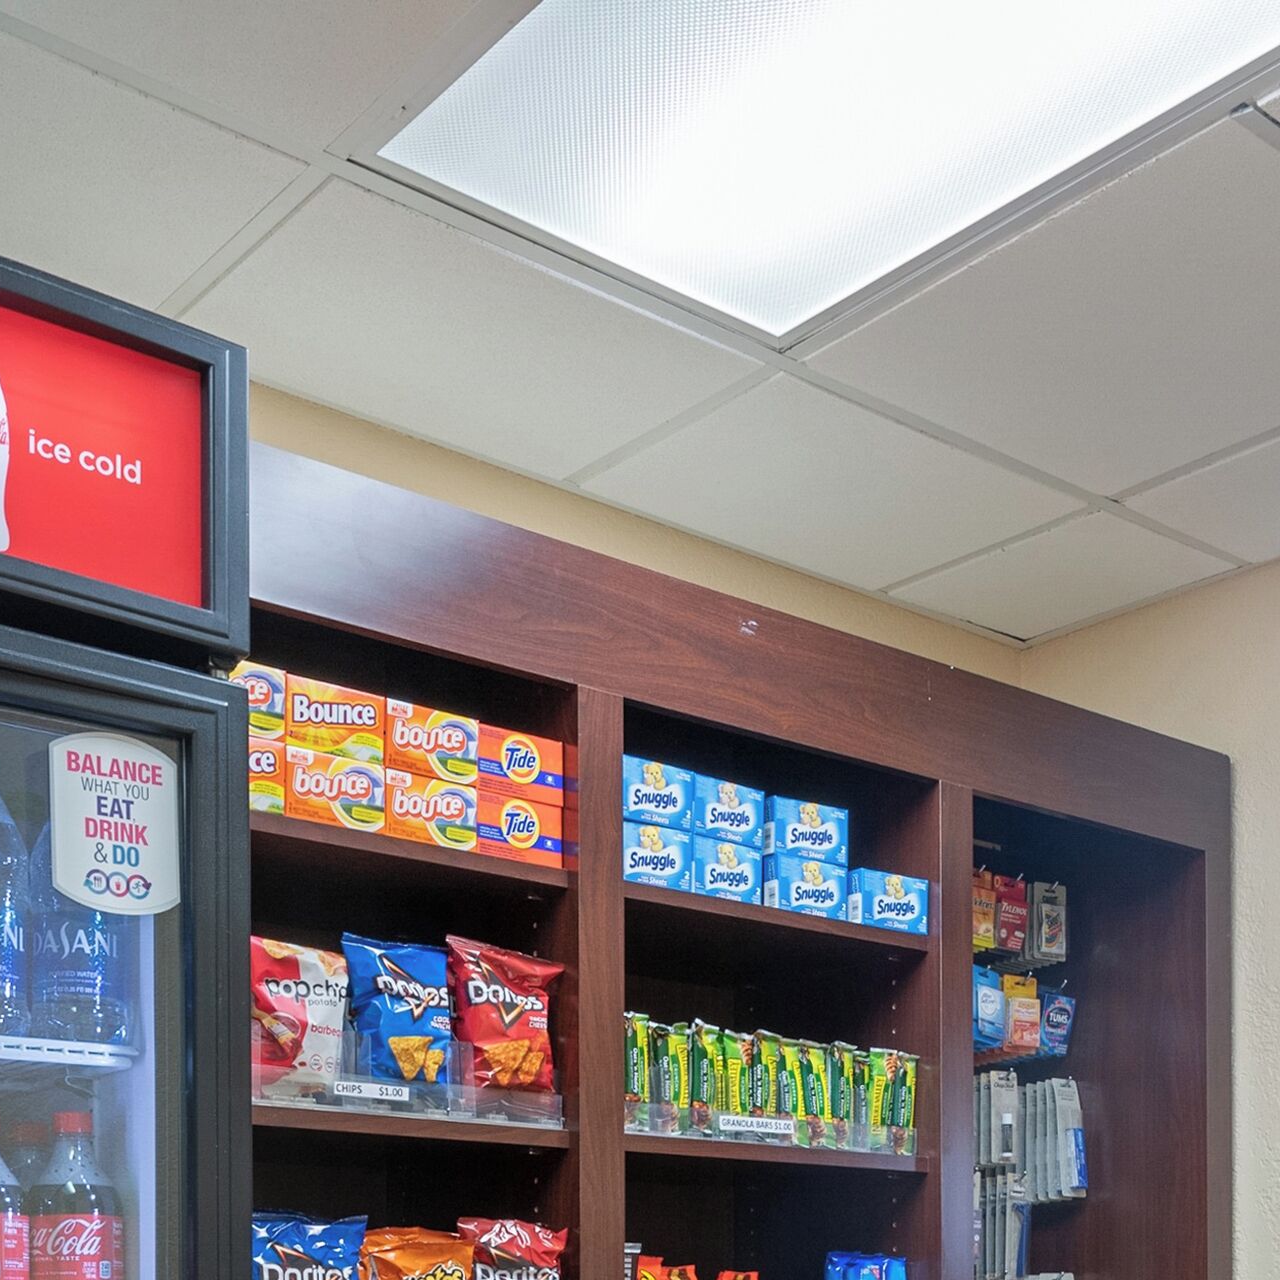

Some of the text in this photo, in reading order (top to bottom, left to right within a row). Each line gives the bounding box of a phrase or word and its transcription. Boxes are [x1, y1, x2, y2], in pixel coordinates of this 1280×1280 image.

[28, 429, 142, 485] ice cold
[292, 694, 376, 726] Bounce
[393, 719, 466, 754] bounce
[66, 750, 163, 786] BALANCE
[505, 748, 536, 771] Tide
[81, 776, 150, 801] WHAT YOU
[293, 766, 372, 803] bounce
[96, 795, 136, 822] EAT,
[393, 788, 466, 823] bounce
[632, 788, 678, 811] Snuggle
[505, 811, 536, 836] Tide
[709, 807, 751, 828] Snuggle
[84, 816, 149, 847] DRINK
[789, 827, 833, 847] Snuggle
[93, 842, 140, 868] & DO
[628, 852, 676, 872] Snuggle
[708, 867, 749, 888] Snuggle
[793, 885, 835, 904] Snuggle
[876, 898, 916, 918] Snuggle
[308, 999, 337, 1008] potato
[1049, 1013, 1069, 1024] TUMS
[335, 1082, 403, 1098] CHIPS $1.00
[721, 1118, 792, 1130] GRANOLA BARS $1.00
